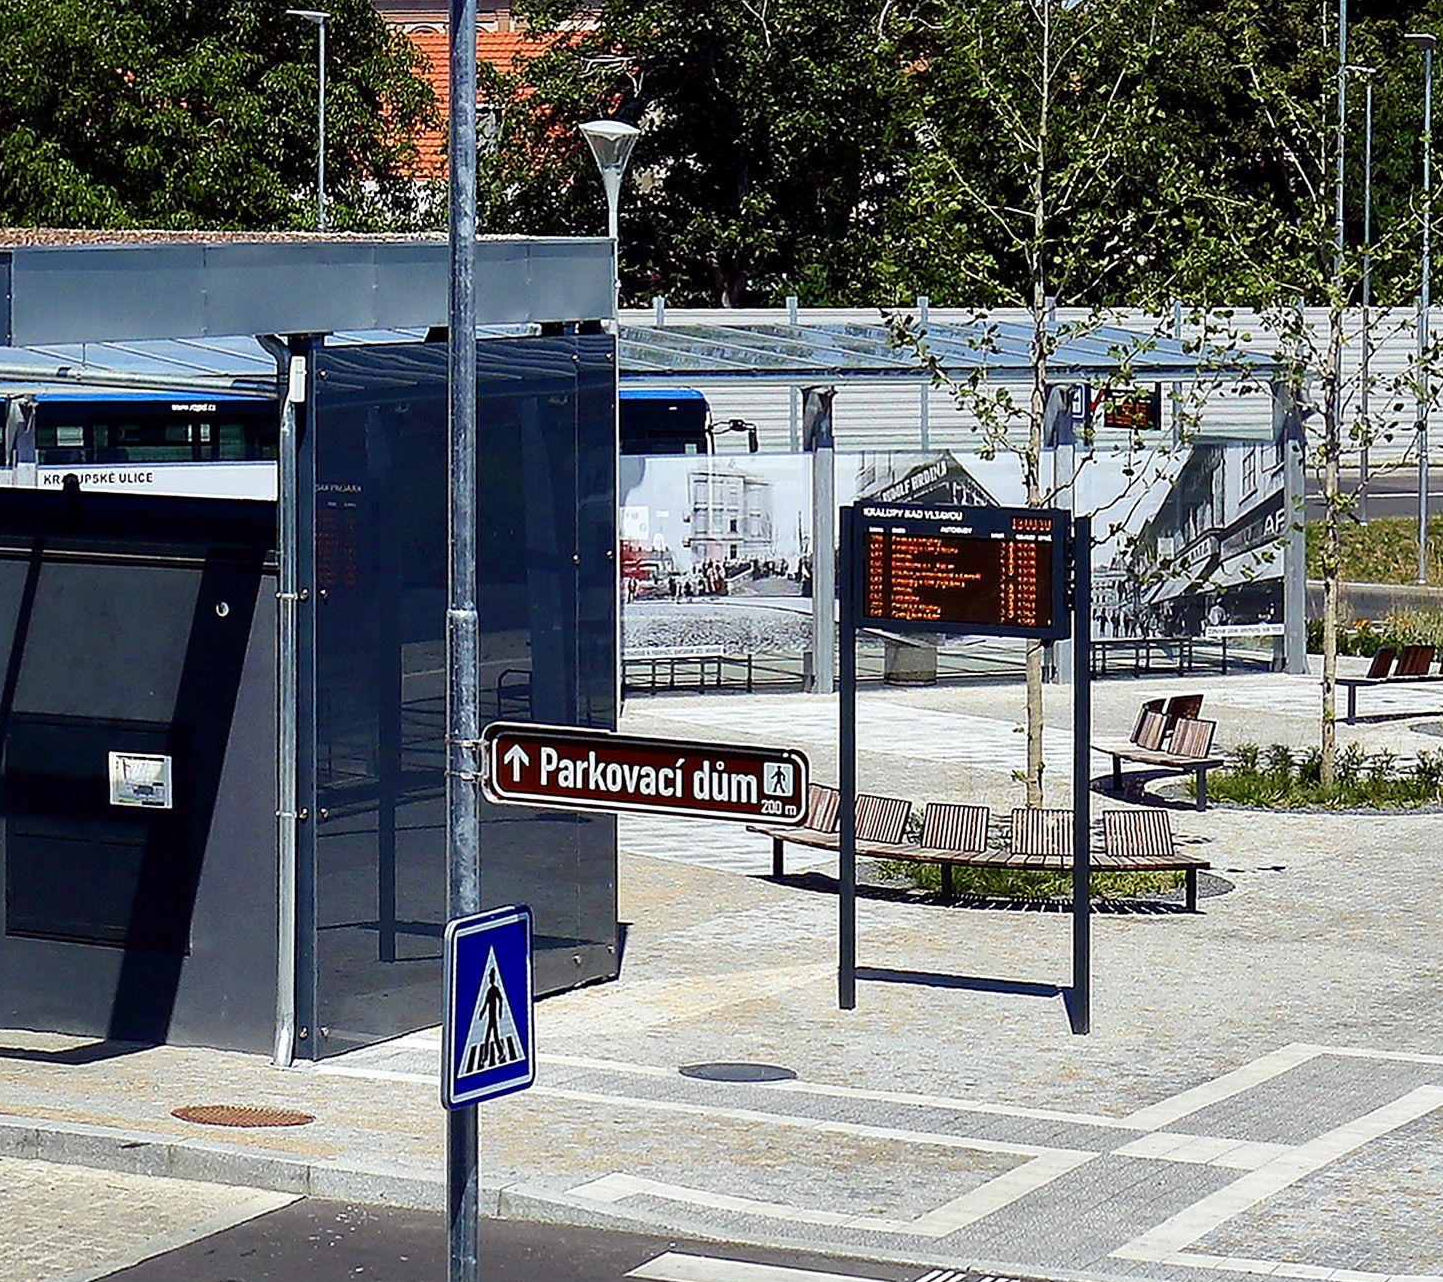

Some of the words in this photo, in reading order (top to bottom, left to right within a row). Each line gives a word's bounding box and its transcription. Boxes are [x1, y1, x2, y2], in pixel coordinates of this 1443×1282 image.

[43, 471, 115, 485] KRAUPSKÉ
[118, 471, 154, 484] ULICE
[539, 746, 686, 798] Parkovací
[692, 760, 758, 805] dům
[760, 799, 782, 815] 200
[784, 805, 797, 817] m
